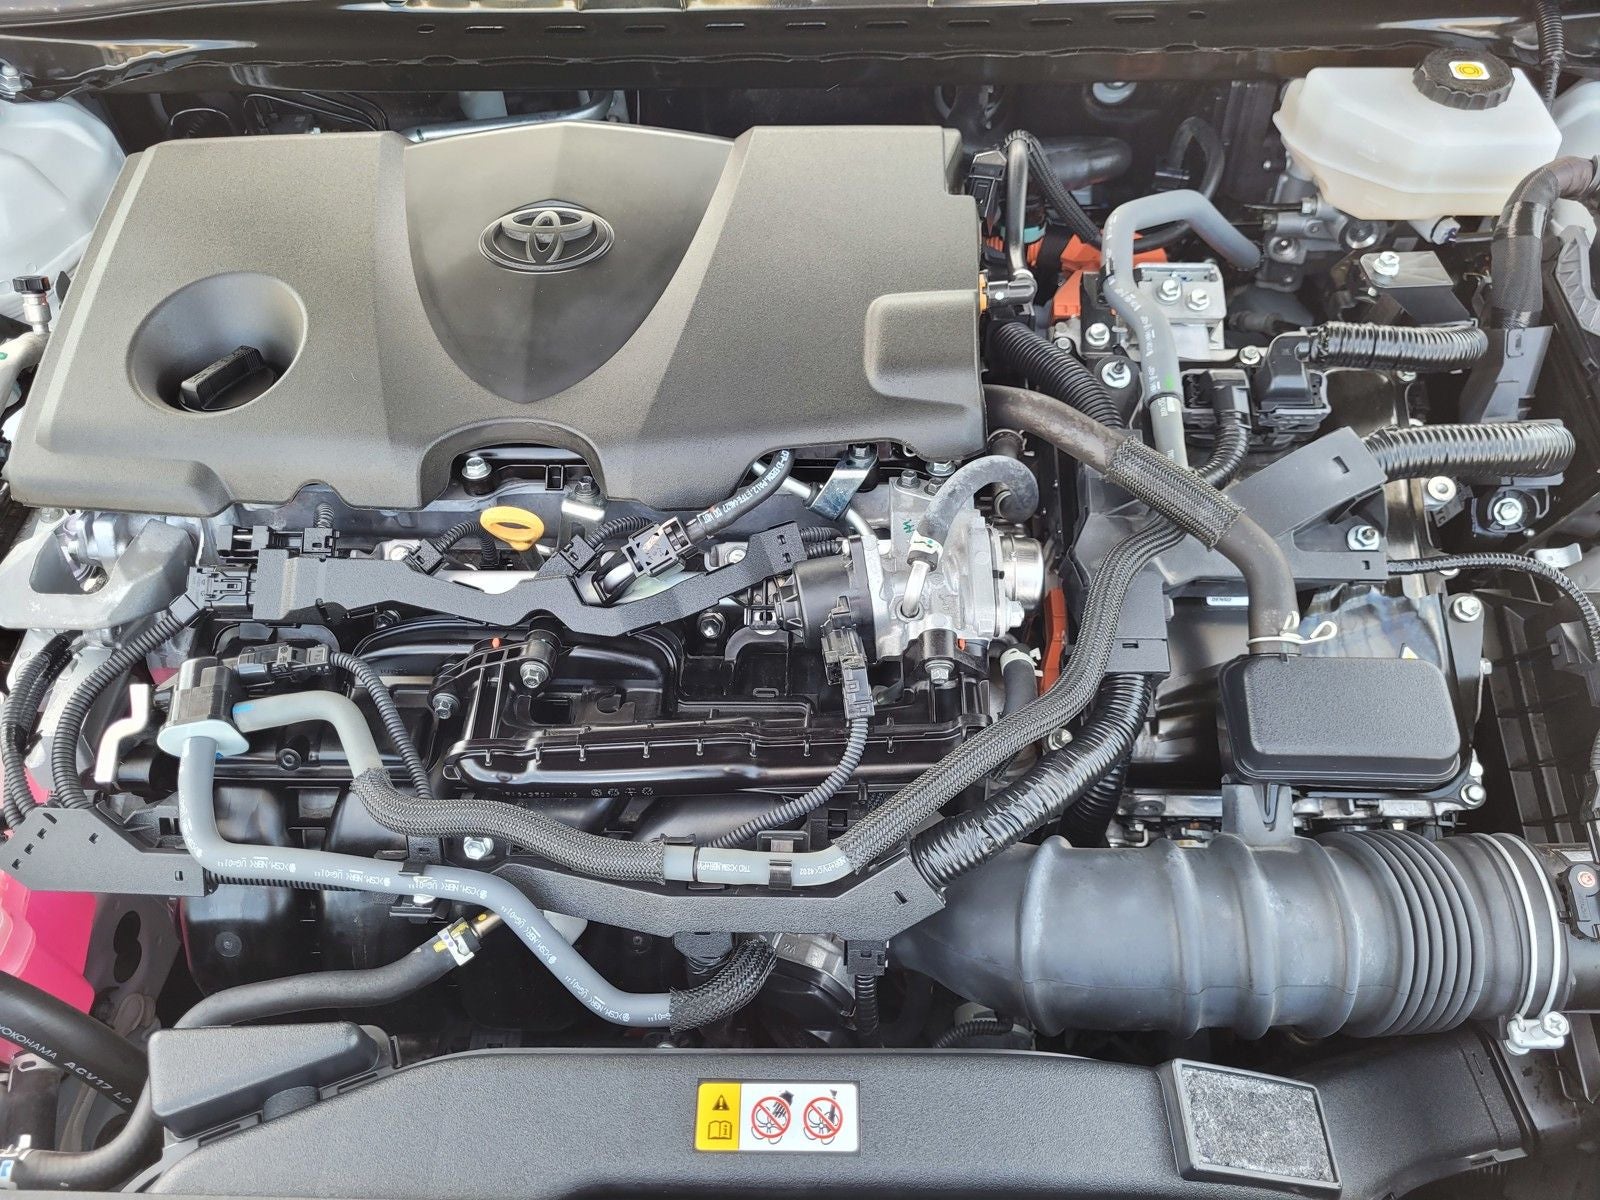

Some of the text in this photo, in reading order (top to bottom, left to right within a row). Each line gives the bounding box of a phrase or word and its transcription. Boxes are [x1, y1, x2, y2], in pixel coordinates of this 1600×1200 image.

[0, 1024, 133, 1104] YOKOHAMA ACV17 LP
